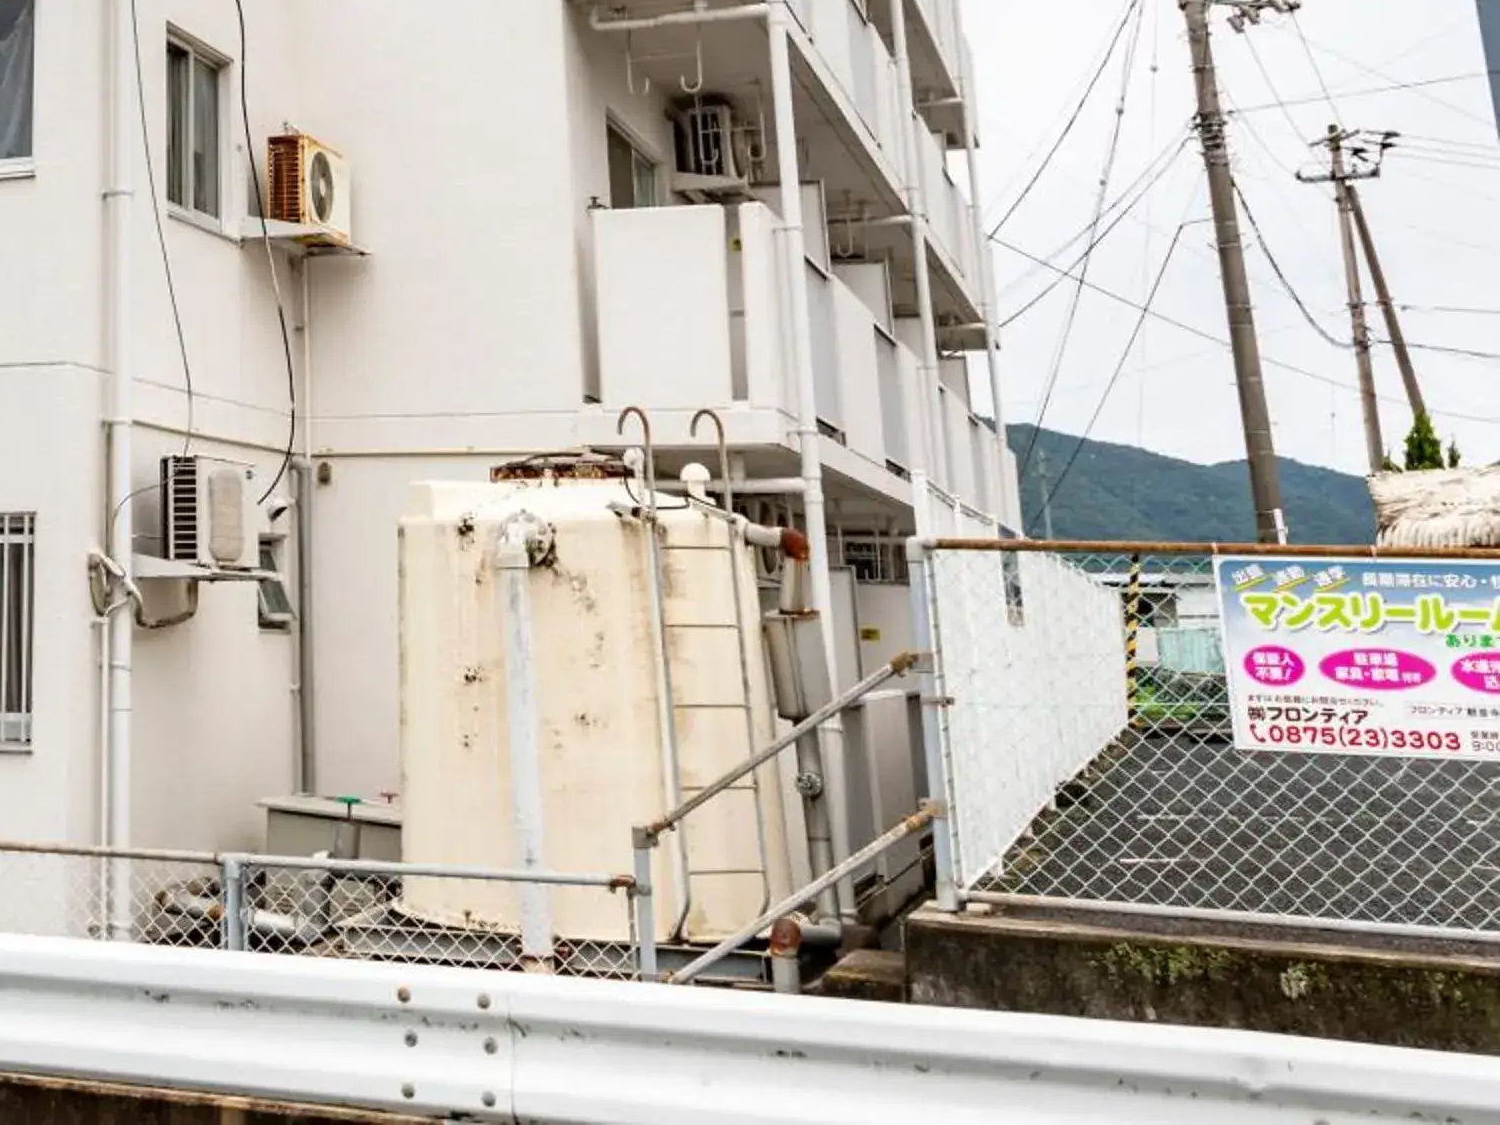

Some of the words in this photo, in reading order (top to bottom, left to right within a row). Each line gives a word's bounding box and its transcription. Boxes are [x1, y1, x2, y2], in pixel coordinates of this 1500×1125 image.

[1445, 634, 1500, 648] ありま
[1269, 724, 1461, 751] 0875(23)3303
